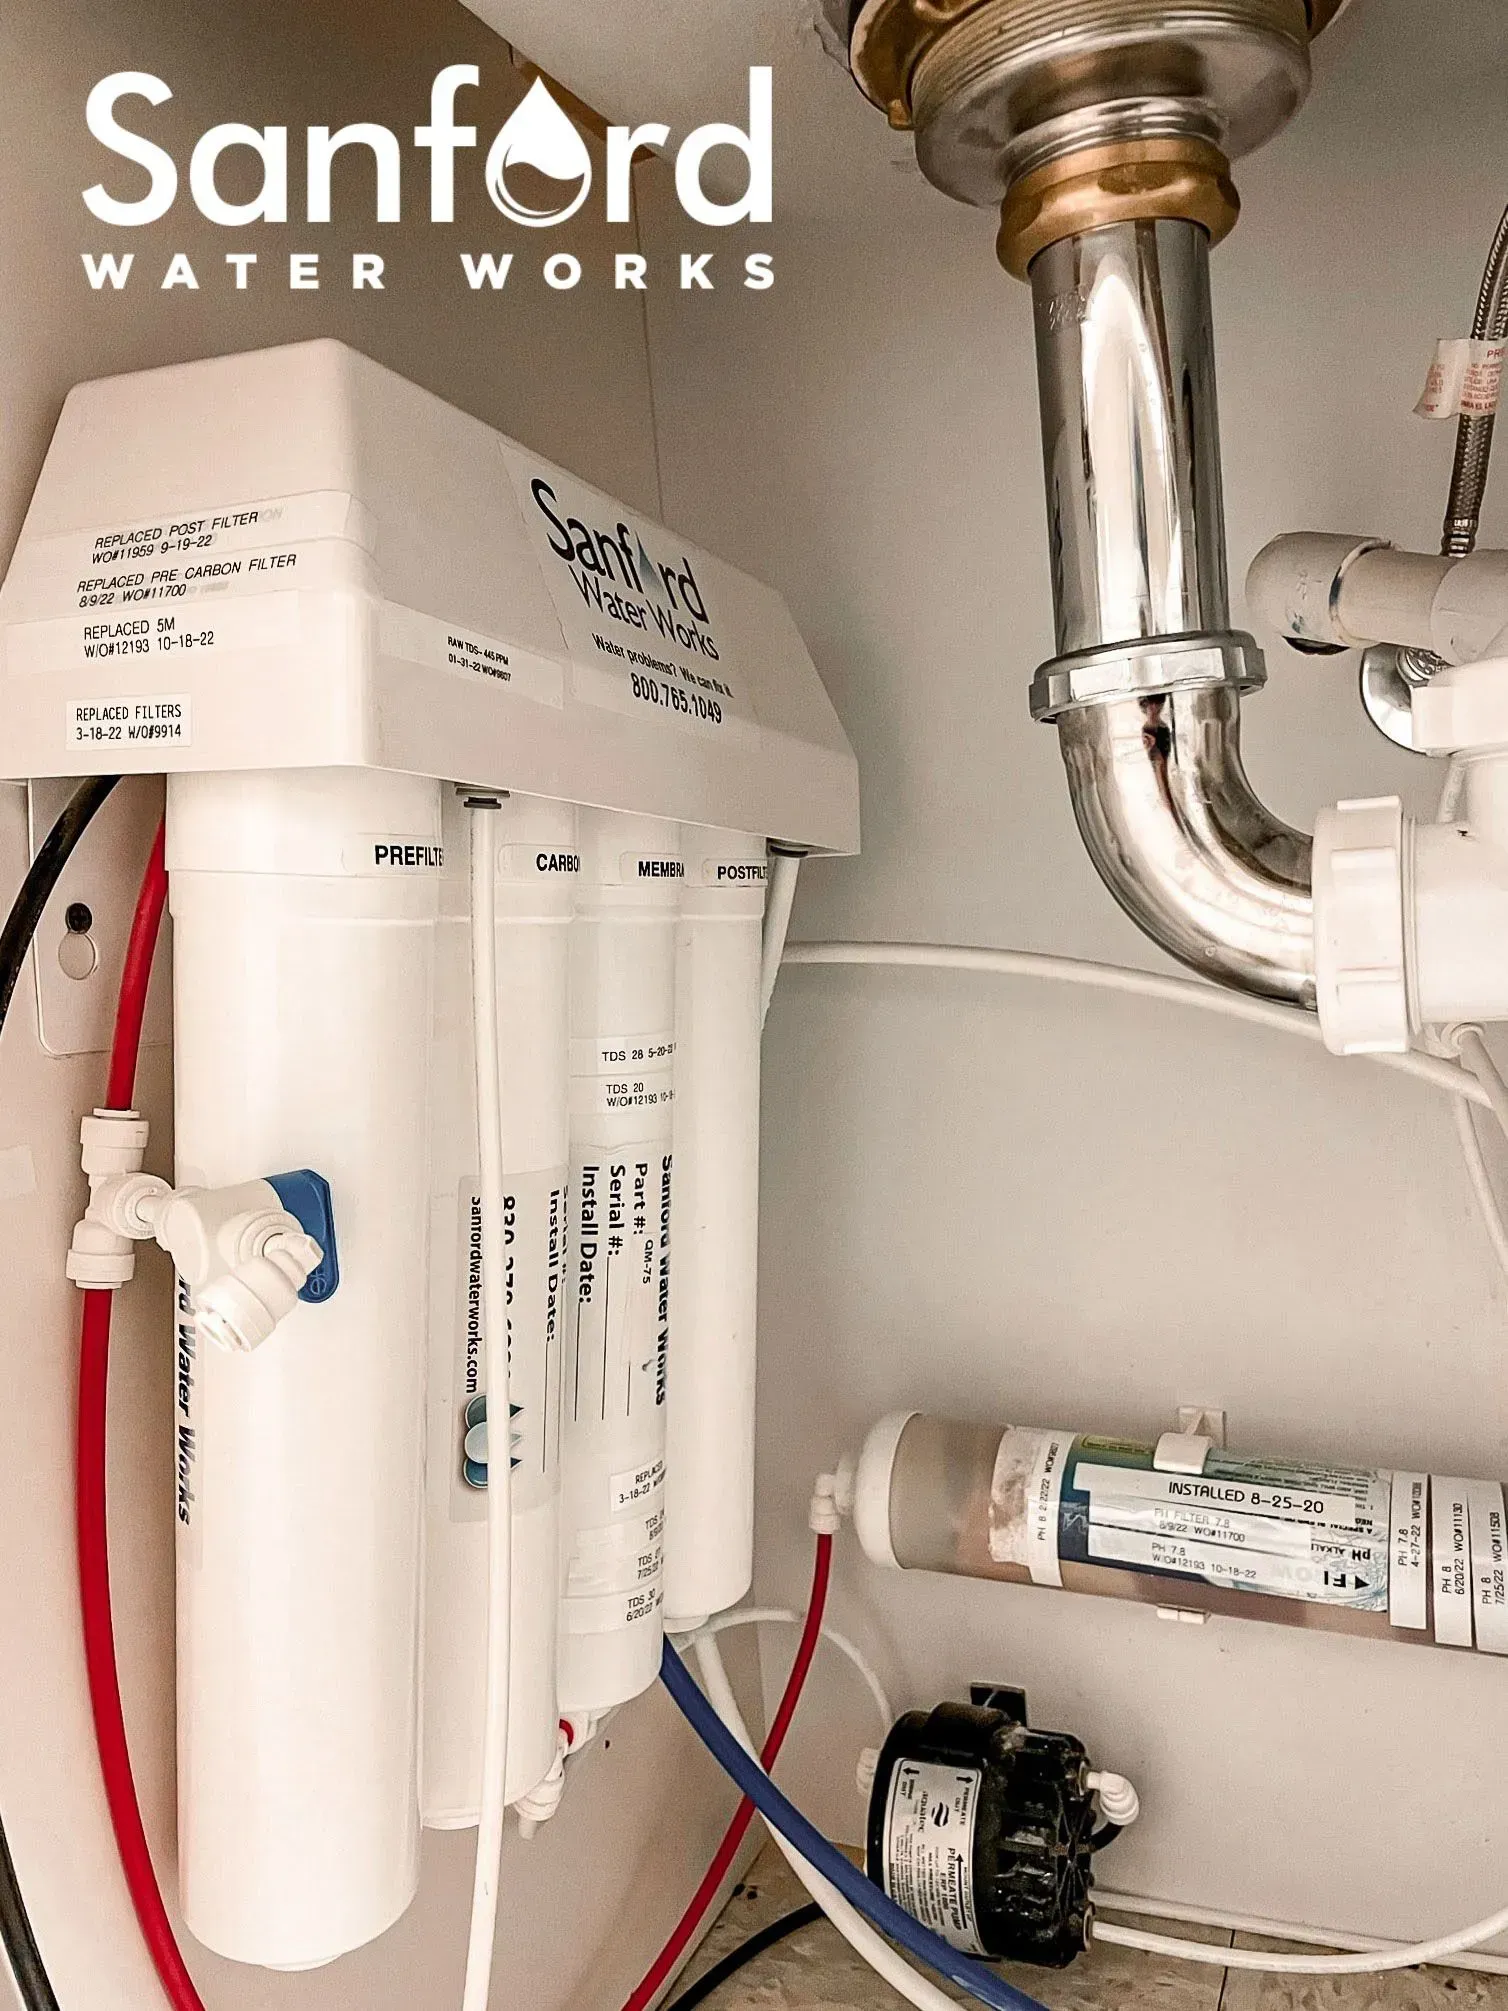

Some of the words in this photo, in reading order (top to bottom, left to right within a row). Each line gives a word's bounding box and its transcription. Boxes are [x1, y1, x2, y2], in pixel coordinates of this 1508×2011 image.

[95, 528, 162, 549] REPLACED
[169, 520, 205, 537] POST
[212, 511, 258, 529] FILTER
[92, 544, 154, 565] WO#11959
[160, 534, 213, 554] 9-19-22
[76, 573, 145, 593] REPLACED
[151, 569, 178, 583] PRE
[185, 561, 241, 580] CARBON
[249, 554, 297, 572] FILTER
[79, 591, 114, 608] 8/9/22
[122, 584, 187, 603] WO#11700
[567, 564, 648, 632] Water
[645, 598, 720, 661] Works
[84, 620, 149, 641] REPLACED
[157, 617, 175, 633] 5M
[84, 638, 150, 658] W/O#12193
[157, 631, 214, 651] 10-18-22
[447, 635, 463, 649] RAW
[496, 653, 509, 665] PPM
[448, 653, 481, 672] 01-31-22
[592, 633, 625, 658] Water
[627, 649, 677, 677] problems?
[679, 666, 696, 684] We
[630, 672, 722, 724] 800.765.1049
[76, 707, 129, 721] REPLACED
[135, 704, 182, 718] FILTERS
[76, 726, 122, 740] 3-18-22
[128, 724, 181, 739] W/O#9914
[536, 853, 580, 872] CARBO
[602, 1051, 626, 1061] TDS
[631, 1049, 644, 1060] 28
[606, 1084, 628, 1094] TDS
[633, 1082, 644, 1093] 20
[608, 1165, 626, 1229] Serial
[633, 1163, 648, 1211] Part
[581, 1166, 600, 1236] Install
[546, 1189, 560, 1268] Install
[633, 1216, 646, 1235] #:
[608, 1235, 623, 1256] #:
[578, 1242, 598, 1303] Date:
[642, 1239, 654, 1284] QM-75
[545, 1273, 558, 1342] Date:
[177, 1322, 196, 1419] Water
[177, 1423, 196, 1526] Works
[1169, 1481, 1245, 1503] INSTALLED
[1251, 1491, 1324, 1514] 8-25-20
[1154, 1508, 1169, 1518] PH
[1174, 1511, 1209, 1524] FILTER
[1215, 1517, 1230, 1528] 7.8
[1194, 1527, 1246, 1542] WO#11700
[1398, 1529, 1408, 1544] 7.8
[1411, 1525, 1421, 1567] 4-27-22
[638, 1553, 652, 1567] TDS
[1152, 1542, 1166, 1551] PH
[1170, 1545, 1186, 1556] 7.8
[1352, 1549, 1371, 1560] pH
[1398, 1551, 1408, 1566] PH
[1211, 1563, 1257, 1579] 10-18-22
[1454, 1558, 1465, 1595] 6/20/22
[1442, 1578, 1452, 1594] PH
[1482, 1589, 1491, 1605] PH
[1493, 1569, 1504, 1605] 7/25/22
[628, 1594, 645, 1608] TDS
[947, 1848, 959, 1905] PERMEATE
[950, 1906, 962, 1931] PUMP
